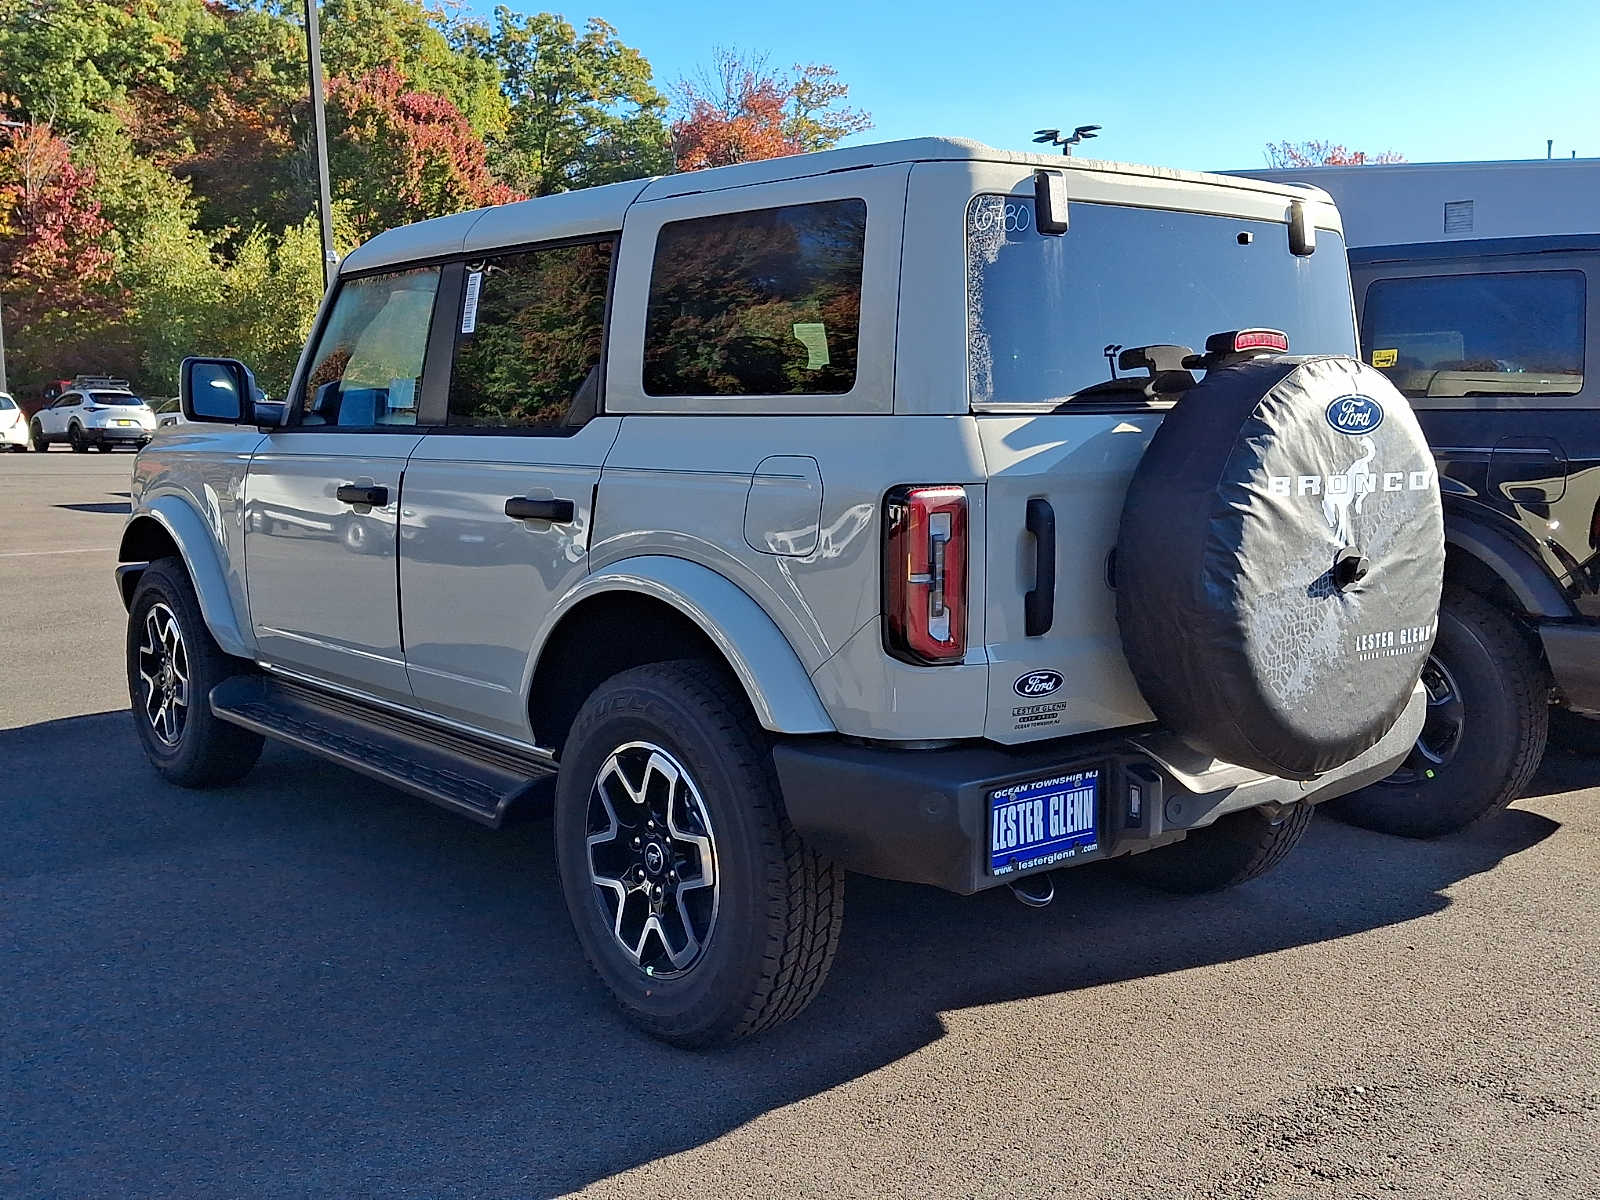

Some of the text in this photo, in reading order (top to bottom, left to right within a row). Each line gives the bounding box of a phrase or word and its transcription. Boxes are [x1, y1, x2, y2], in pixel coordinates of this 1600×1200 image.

[975, 198, 1030, 231] 6780
[1337, 400, 1371, 427] Ford
[1267, 472, 1430, 497] BRONCO
[1355, 625, 1431, 652] LESTER GLENN
[1025, 675, 1056, 692] Ford
[1042, 702, 1067, 713] GLENN
[994, 770, 1098, 798] OCEAN TOWNSHIP NJ
[992, 789, 1094, 851] LESTER GLENN
[1018, 849, 1075, 870] lesterglenn
